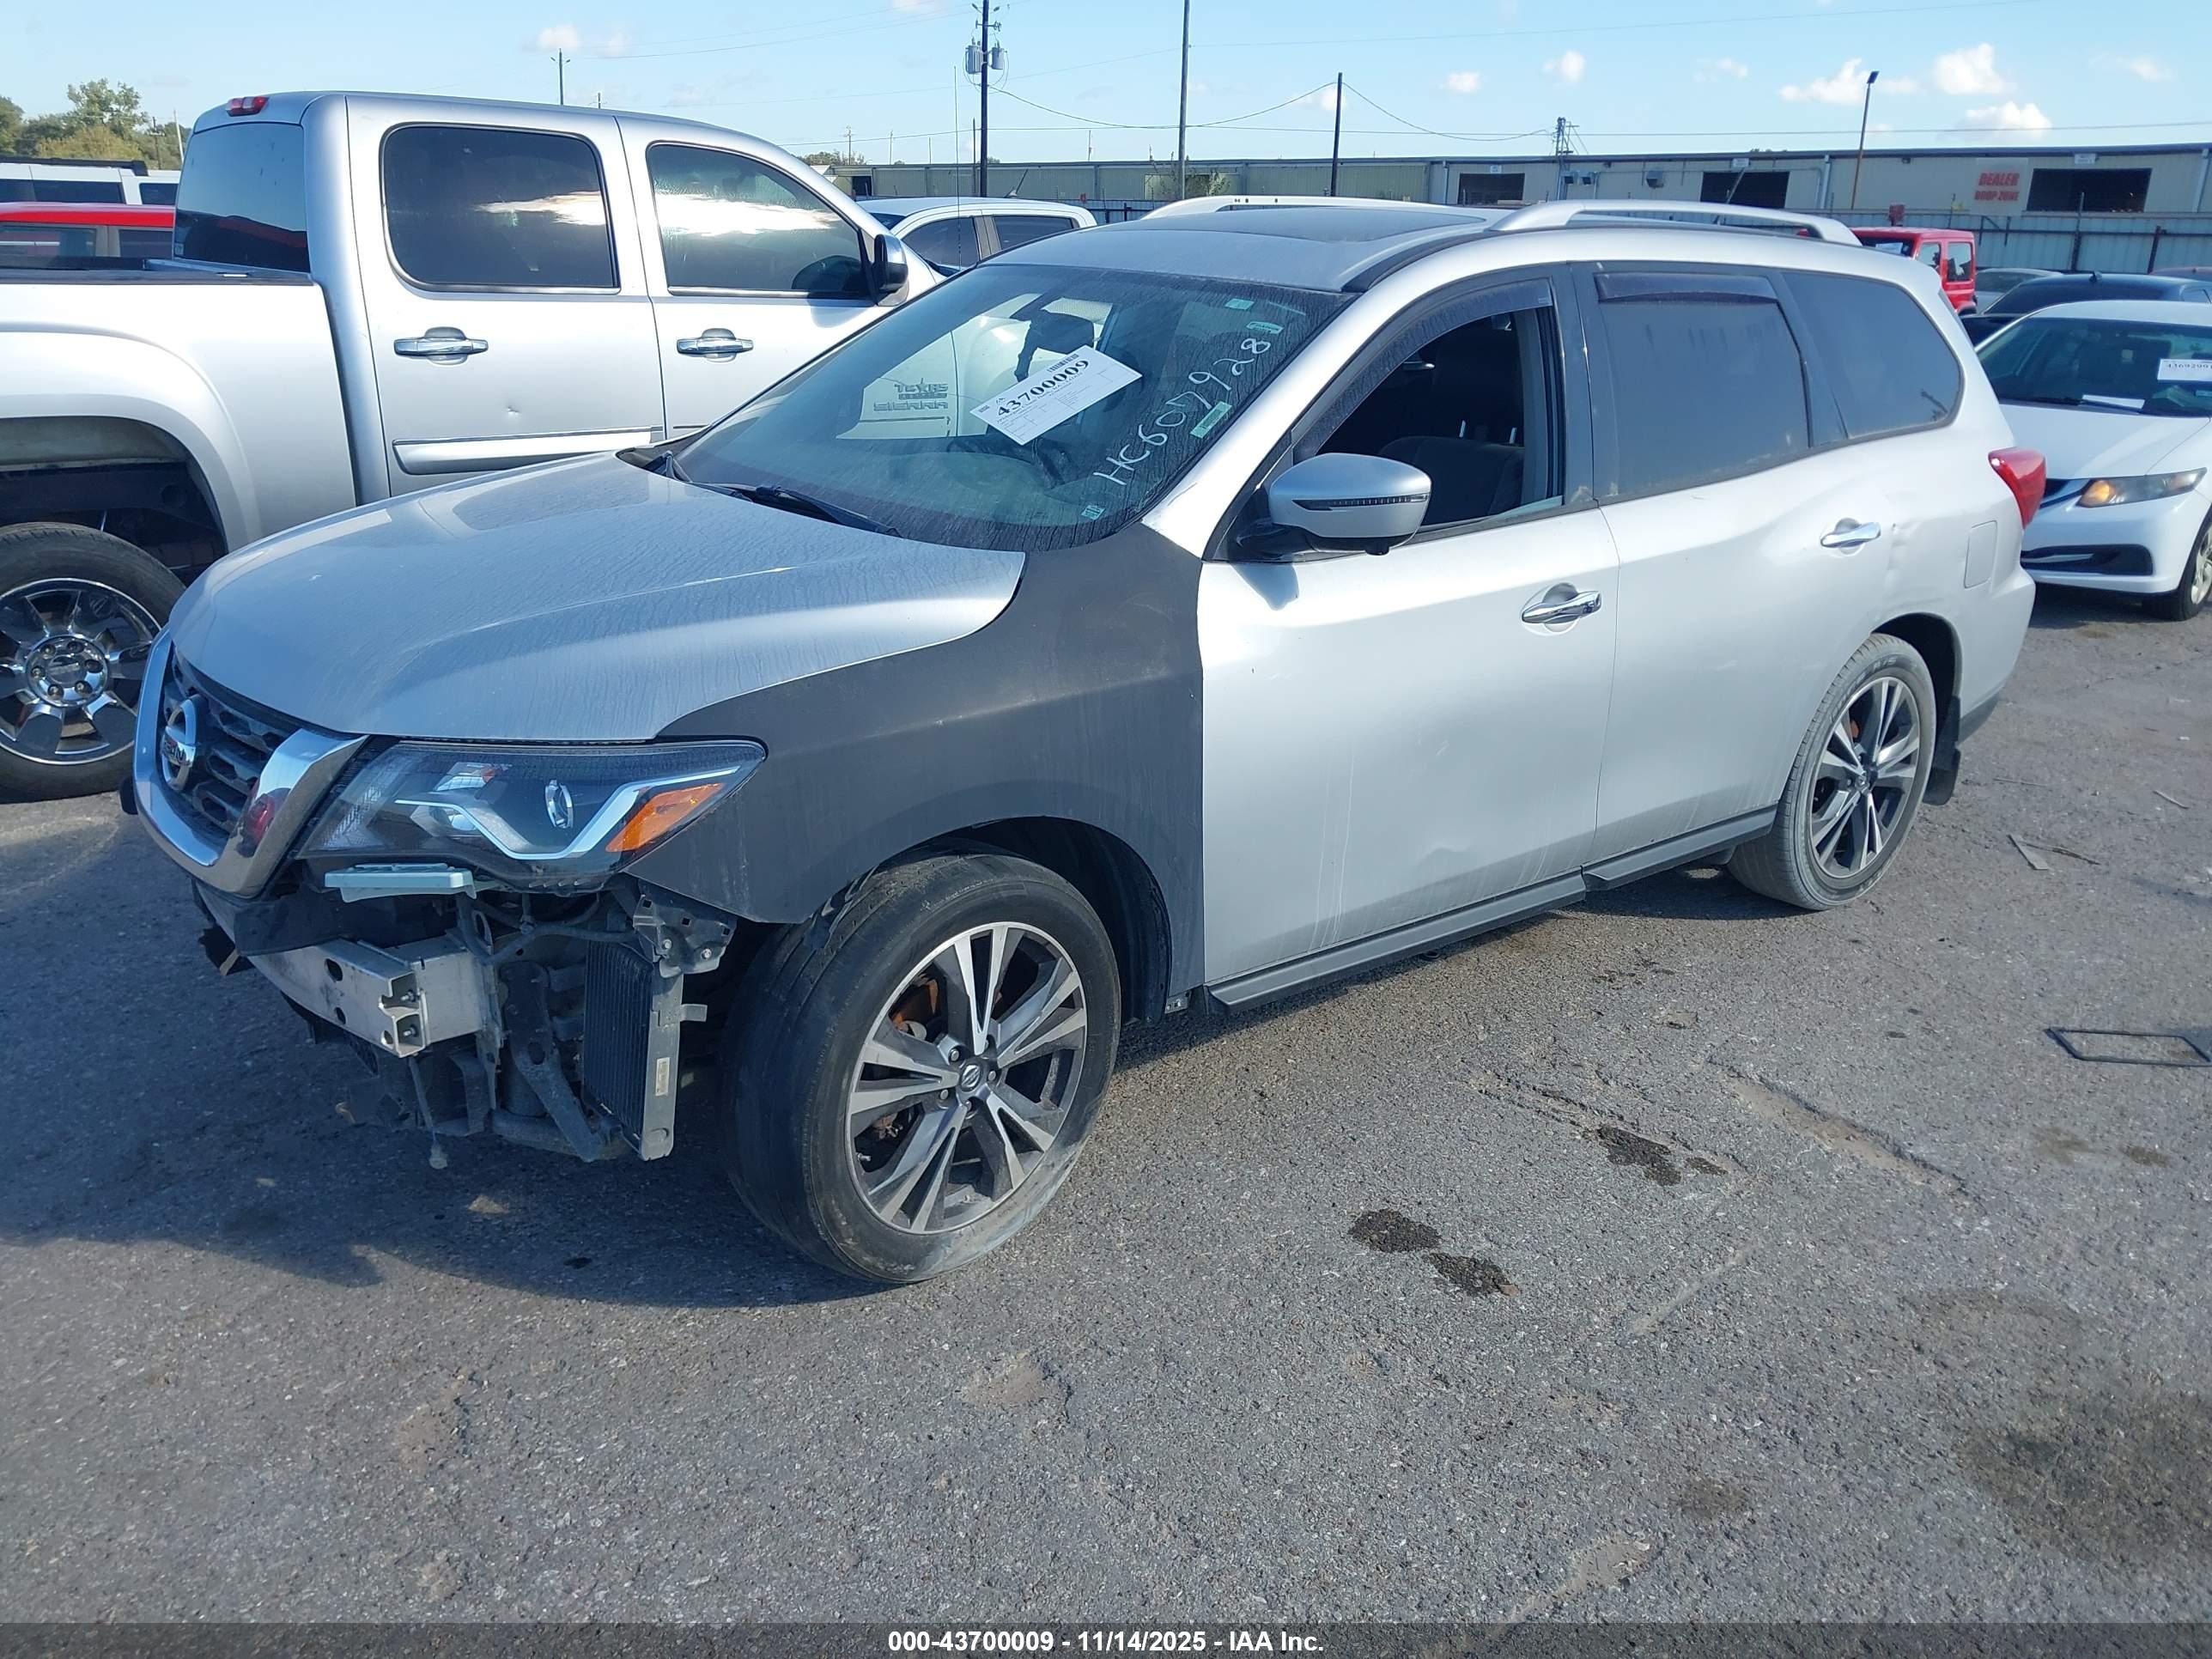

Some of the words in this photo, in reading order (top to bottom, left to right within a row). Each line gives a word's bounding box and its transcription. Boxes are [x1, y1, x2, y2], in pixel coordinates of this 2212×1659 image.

[1978, 172, 2020, 186] DEALER
[894, 383, 949, 393] TEXAS
[997, 359, 1090, 416] 43700009
[873, 400, 949, 412] SIERRA
